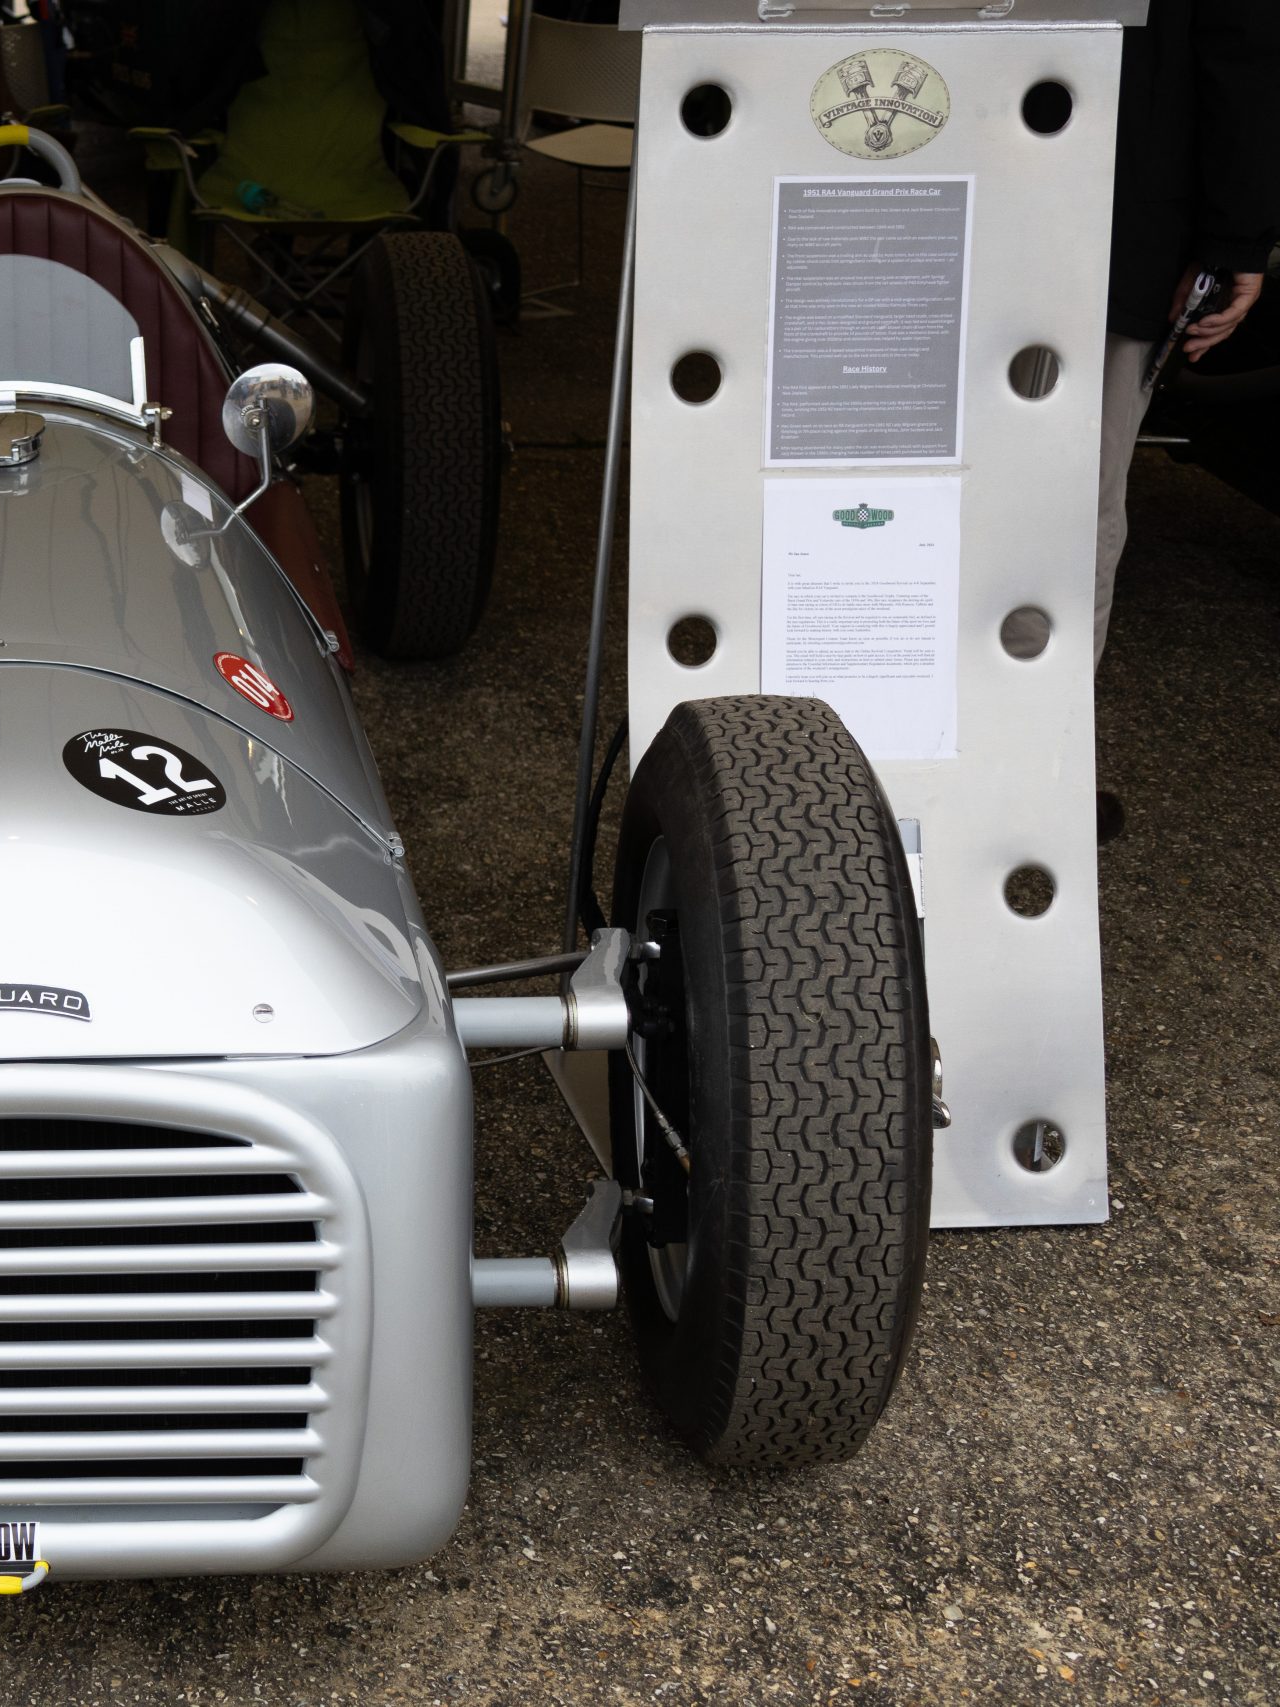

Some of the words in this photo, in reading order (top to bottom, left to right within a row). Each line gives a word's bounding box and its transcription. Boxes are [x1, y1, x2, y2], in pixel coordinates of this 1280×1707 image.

[823, 99, 871, 120] VINTAGE
[874, 98, 938, 125] INNOVATION
[803, 188, 821, 197] 1951
[821, 188, 836, 197] RA4
[837, 188, 871, 198] Vanguard
[872, 188, 893, 196] Grand
[895, 188, 909, 196] Prix
[910, 188, 927, 196] Race
[928, 188, 941, 196] Car
[842, 365, 860, 374] Race
[861, 365, 888, 374] History
[231, 663, 280, 708] 014
[76, 731, 107, 743] The
[98, 745, 216, 806] 12
[175, 797, 217, 811] MALLE
